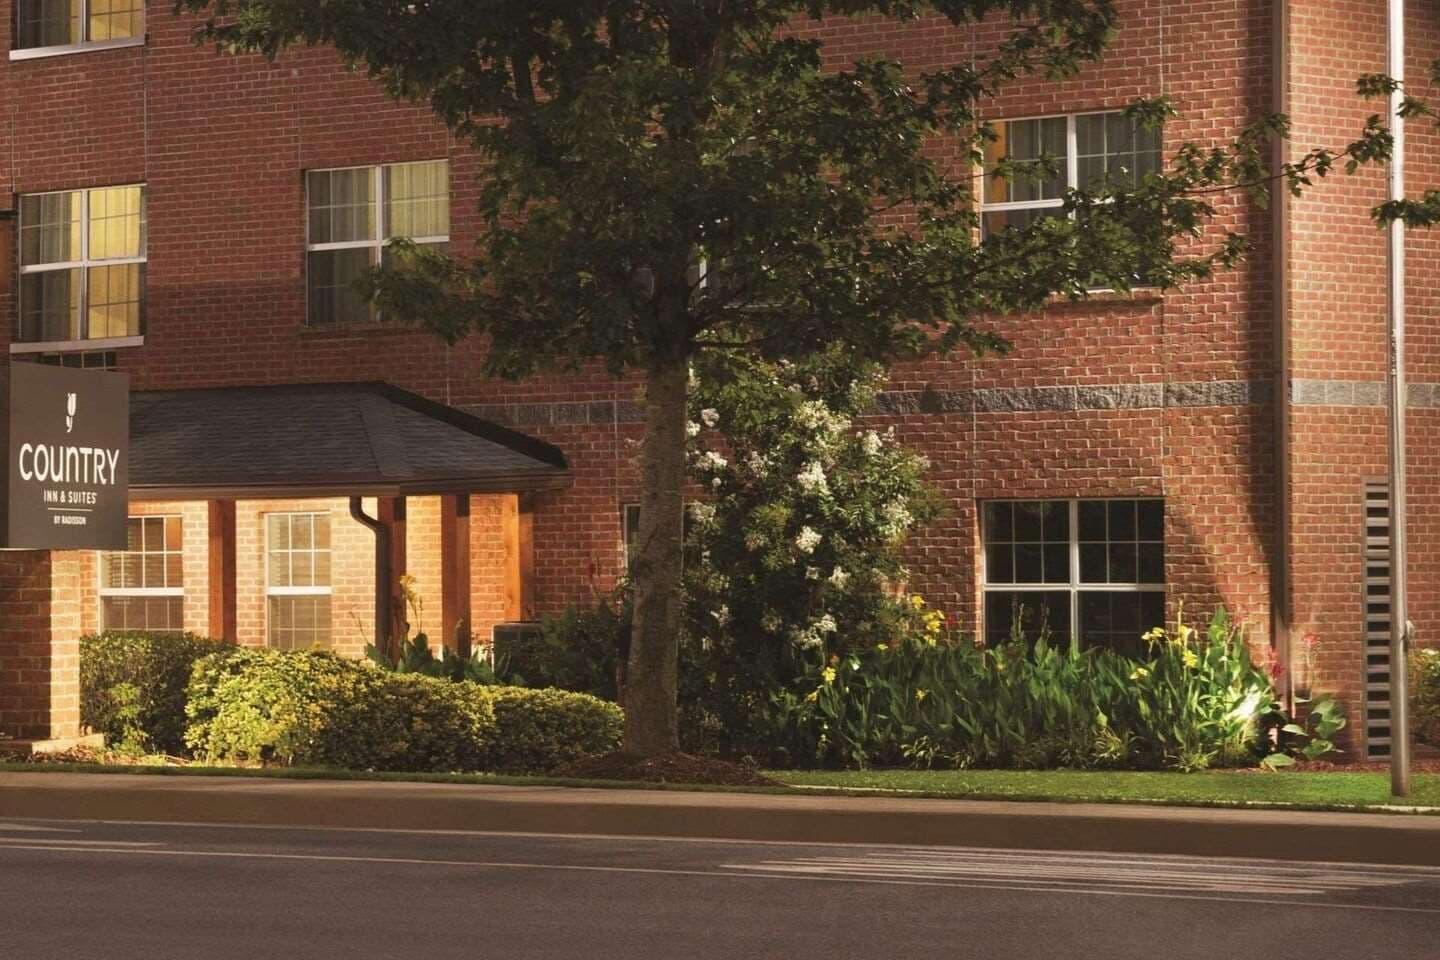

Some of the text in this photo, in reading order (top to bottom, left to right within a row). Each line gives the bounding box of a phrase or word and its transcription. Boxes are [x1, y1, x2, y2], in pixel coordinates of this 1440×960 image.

[19, 443, 120, 485] COUNTRY
[43, 489, 97, 505] INN & SUITES
